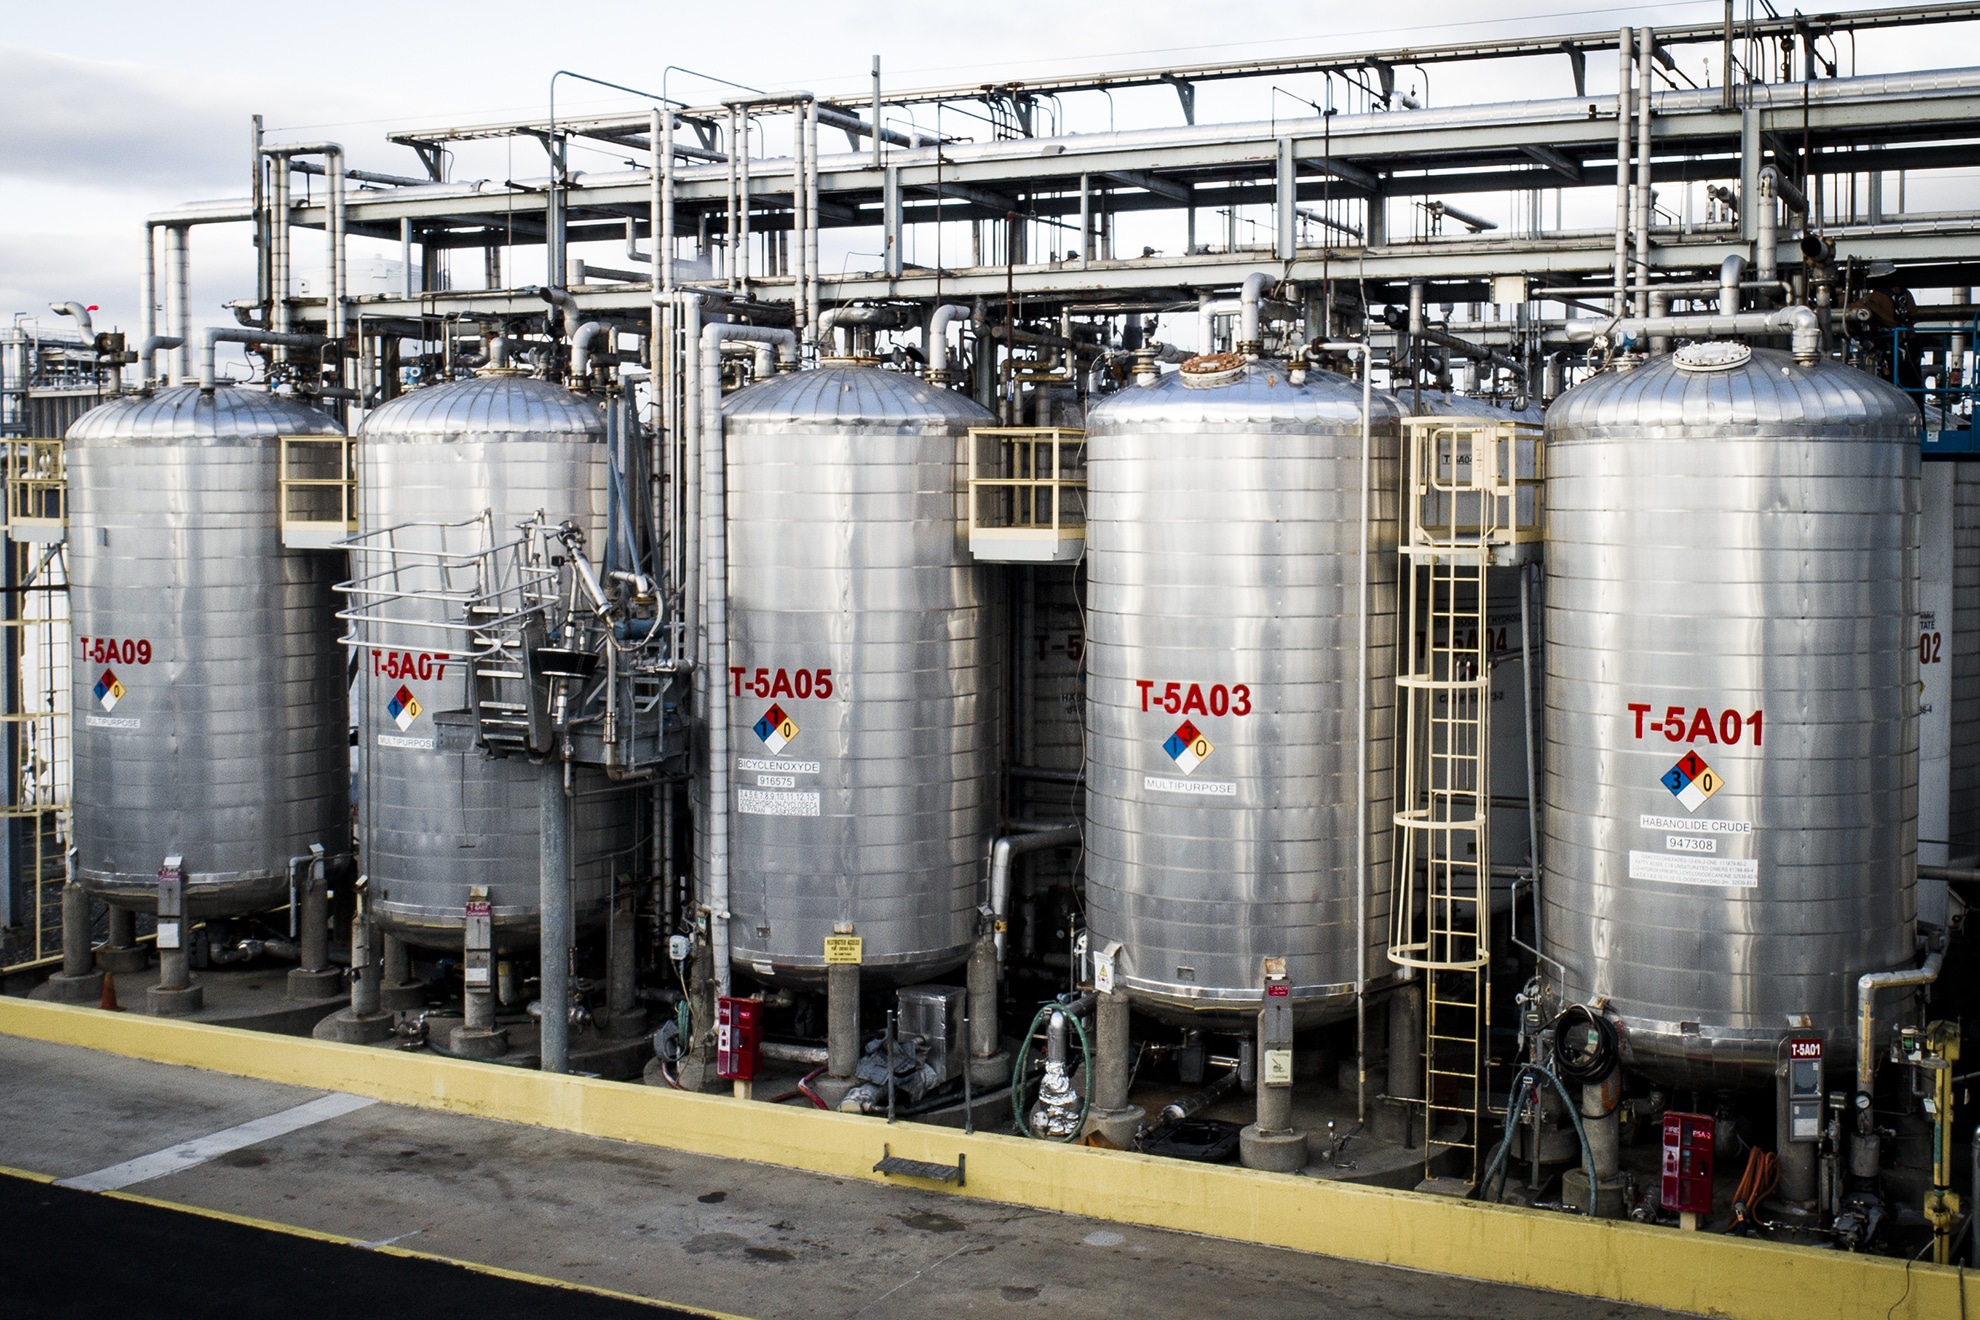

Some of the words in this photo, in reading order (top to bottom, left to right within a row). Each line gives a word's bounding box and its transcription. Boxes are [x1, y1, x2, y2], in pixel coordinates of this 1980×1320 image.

[80, 637, 152, 665] T-5A09
[1920, 631, 1941, 664] 02
[372, 650, 450, 681] T-5A07
[105, 673, 111, 684] 3
[730, 667, 833, 699] T-5A05
[114, 685, 119, 697] 0
[400, 689, 407, 703] 3
[1136, 680, 1252, 717] T-5A03
[393, 701, 399, 715] 1
[410, 702, 417, 716] 0
[771, 708, 779, 725] 1
[87, 716, 139, 728] MULTIPURPOSE
[760, 720, 768, 737] 1
[783, 722, 791, 738] 0
[1627, 703, 1763, 746] T-5A01
[1183, 725, 1193, 742] 3
[1172, 738, 1177, 754] 1
[1195, 739, 1207, 757] 0
[738, 759, 819, 772] BICYCLENOXYDE
[1686, 756, 1696, 776] 1
[759, 776, 793, 786] 916575
[1146, 779, 1235, 794] MULTIPURPOSE
[1671, 770, 1681, 790] 3
[1703, 773, 1713, 792] 0
[1642, 817, 1708, 831] HABANOLIDE
[1711, 821, 1750, 832] CRUDE
[1669, 837, 1713, 850] 947308
[1791, 1043, 1821, 1056] T-5A01
